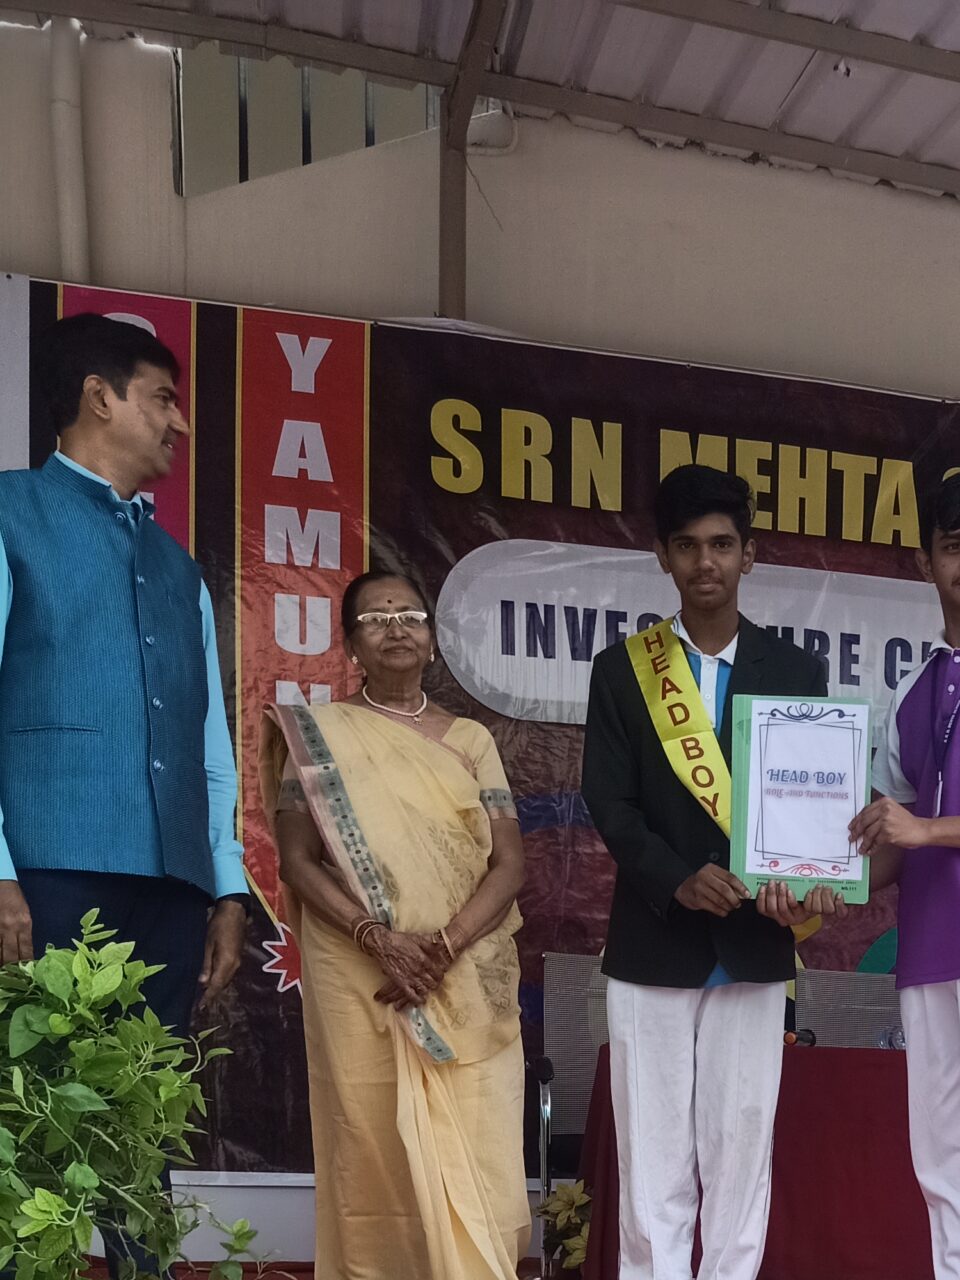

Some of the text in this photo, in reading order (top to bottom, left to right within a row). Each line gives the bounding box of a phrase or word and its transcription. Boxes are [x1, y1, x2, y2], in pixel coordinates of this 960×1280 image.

[430, 398, 622, 512] SRN
[643, 630, 720, 817] HEAD BOY
[766, 768, 848, 785] HEAD BOY
